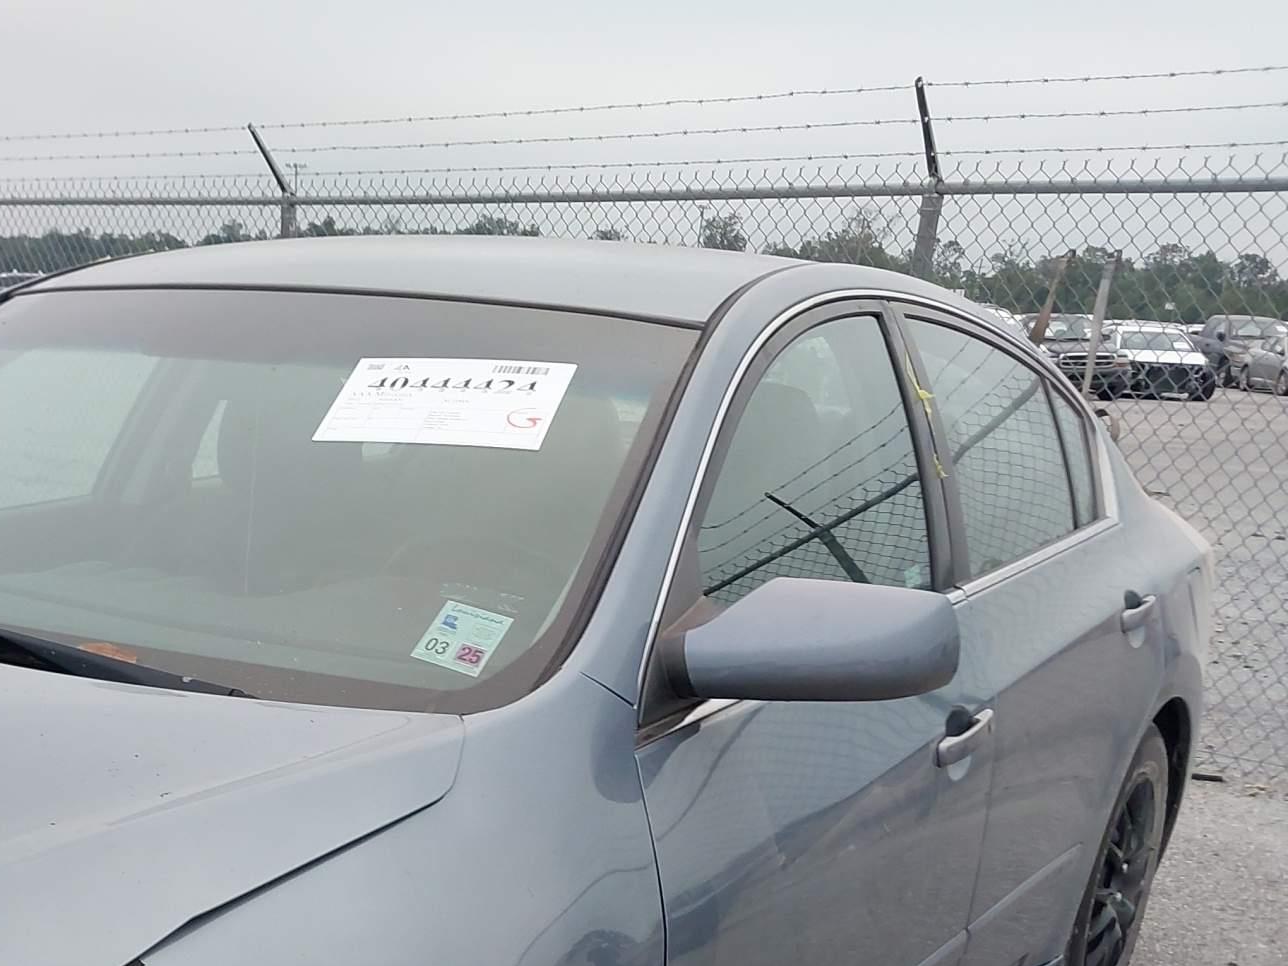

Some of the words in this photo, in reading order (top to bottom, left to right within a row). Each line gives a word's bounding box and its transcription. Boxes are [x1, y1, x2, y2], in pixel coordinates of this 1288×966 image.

[367, 376, 537, 396] 40444424
[424, 637, 450, 655] 03
[457, 646, 485, 664] 25
